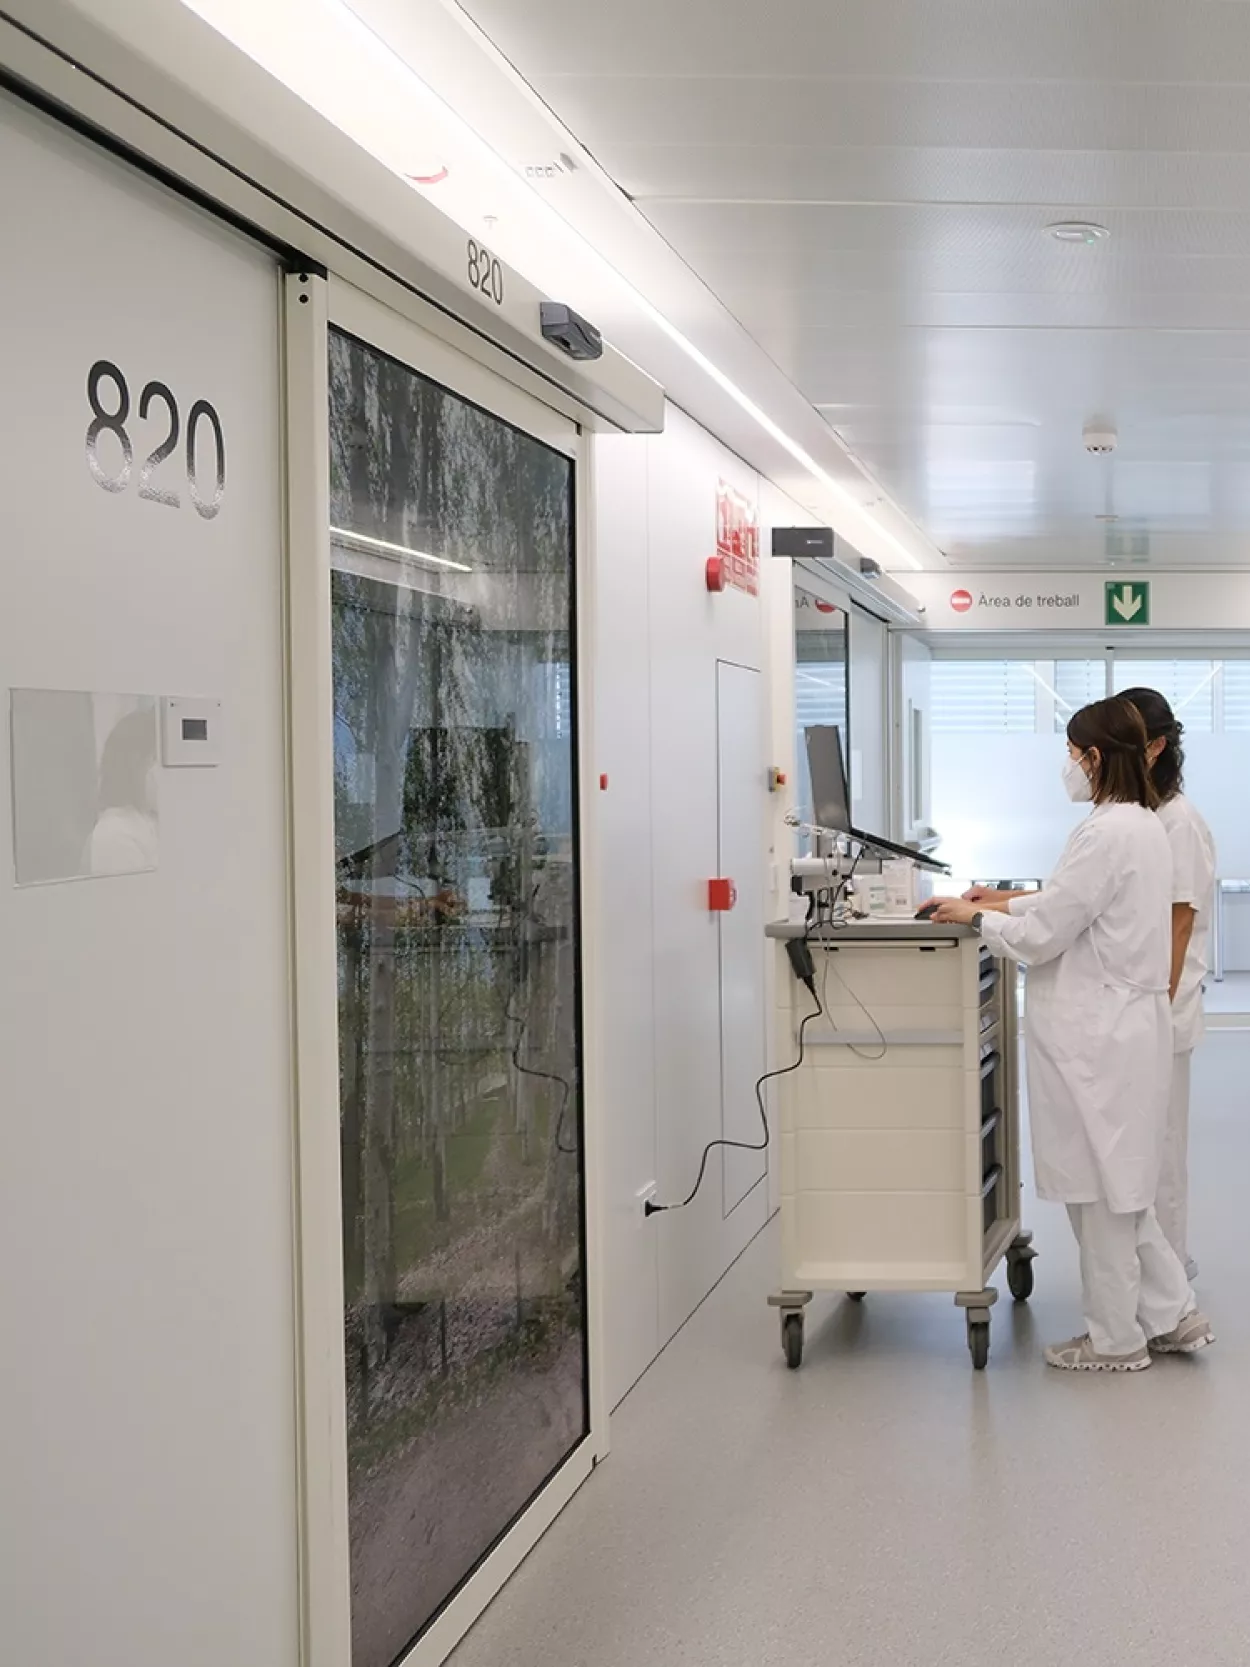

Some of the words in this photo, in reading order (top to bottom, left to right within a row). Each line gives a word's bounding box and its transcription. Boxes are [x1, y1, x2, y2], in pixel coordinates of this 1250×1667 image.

[467, 239, 503, 306] 820
[86, 359, 226, 520] 820
[1015, 594, 1033, 608] de
[1036, 593, 1080, 608] treball
